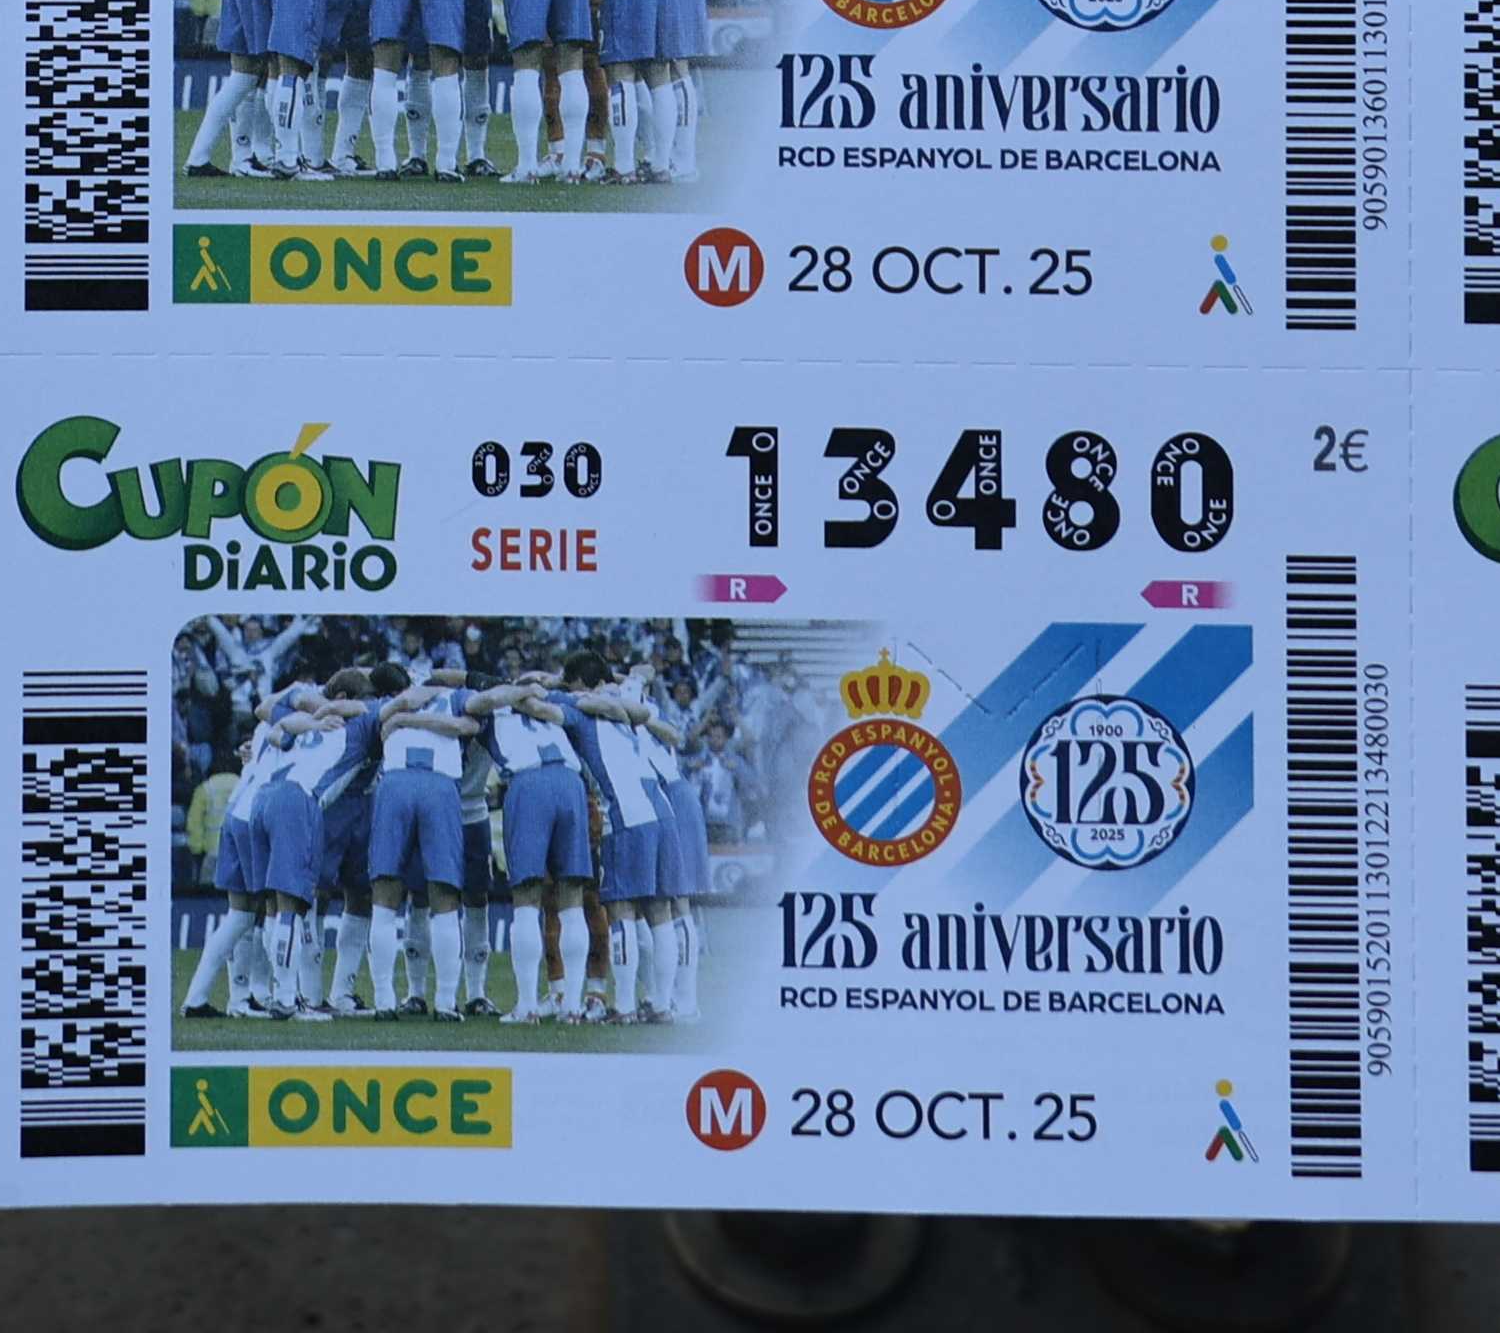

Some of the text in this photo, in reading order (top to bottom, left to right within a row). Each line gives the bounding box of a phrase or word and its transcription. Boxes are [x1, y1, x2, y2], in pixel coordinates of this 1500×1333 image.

[775, 53, 1220, 134] 125 aniversario
[778, 146, 1221, 172] RCD ESPANYOL DE BARCELONA
[267, 236, 495, 294] ONCE
[698, 244, 751, 292] M
[788, 245, 1093, 296] 28 OCT. 25
[471, 441, 602, 499] 030
[1313, 425, 1369, 473] 2€
[725, 426, 1234, 553] 13480
[471, 526, 599, 573] SERIE
[1363, 664, 1391, 1076] 905901520113012213480030
[777, 892, 1224, 975] 125 aniversario
[780, 986, 1225, 1015] RCD ESPANYOL DE BARCELONA
[266, 1076, 495, 1138] ONCE
[700, 1087, 753, 1136] M
[791, 1088, 1097, 1142] 28 OCT. 25
